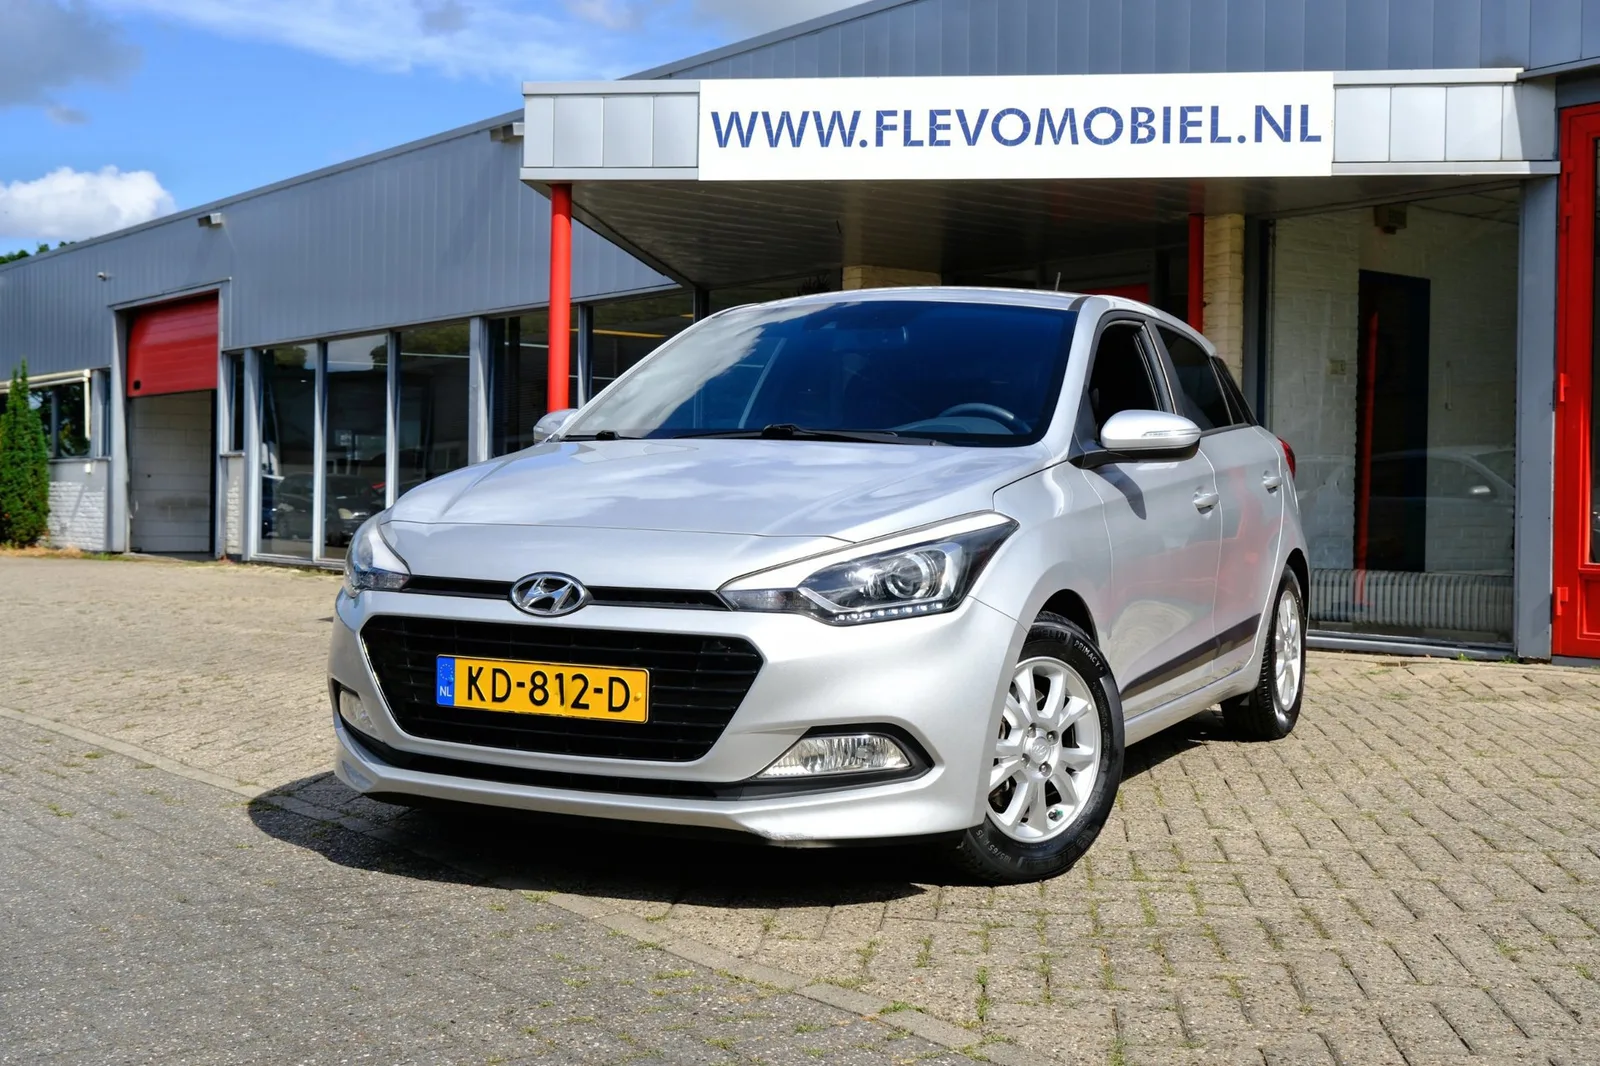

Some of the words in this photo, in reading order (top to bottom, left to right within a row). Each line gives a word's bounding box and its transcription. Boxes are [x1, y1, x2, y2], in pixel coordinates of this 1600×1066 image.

[710, 104, 1322, 148] WWW.FLEVOMOBIEL.NL
[1073, 640, 1100, 667] PRIMACY
[439, 686, 453, 697] NL
[467, 666, 631, 713] KD-812-D
